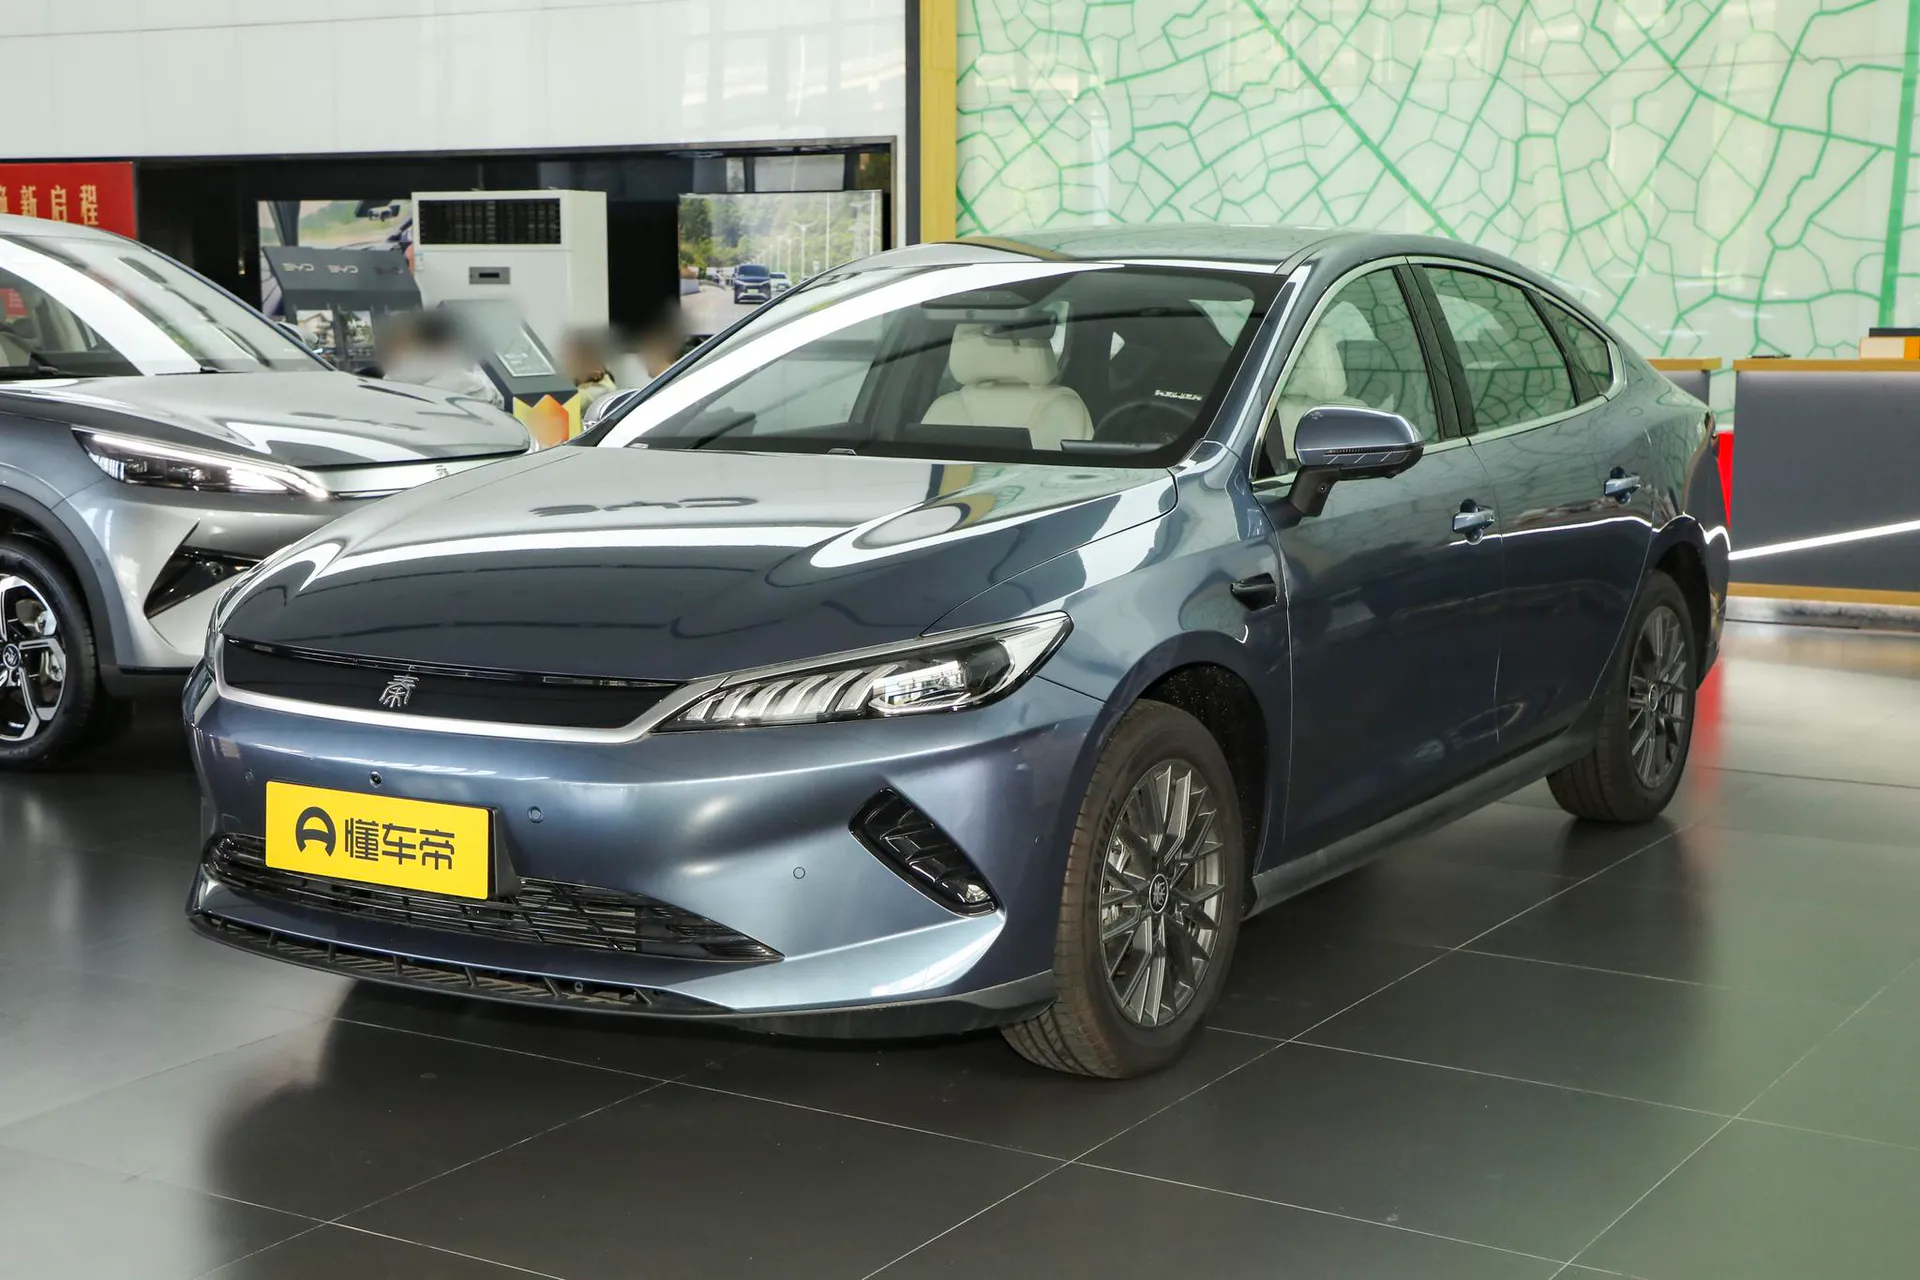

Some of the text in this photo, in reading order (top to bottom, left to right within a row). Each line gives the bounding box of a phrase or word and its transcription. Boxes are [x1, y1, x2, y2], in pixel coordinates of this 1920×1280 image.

[281, 262, 315, 272] BYD
[327, 264, 359, 274] BYD
[378, 674, 420, 708] 秦
[344, 817, 455, 870] 懂车帝
